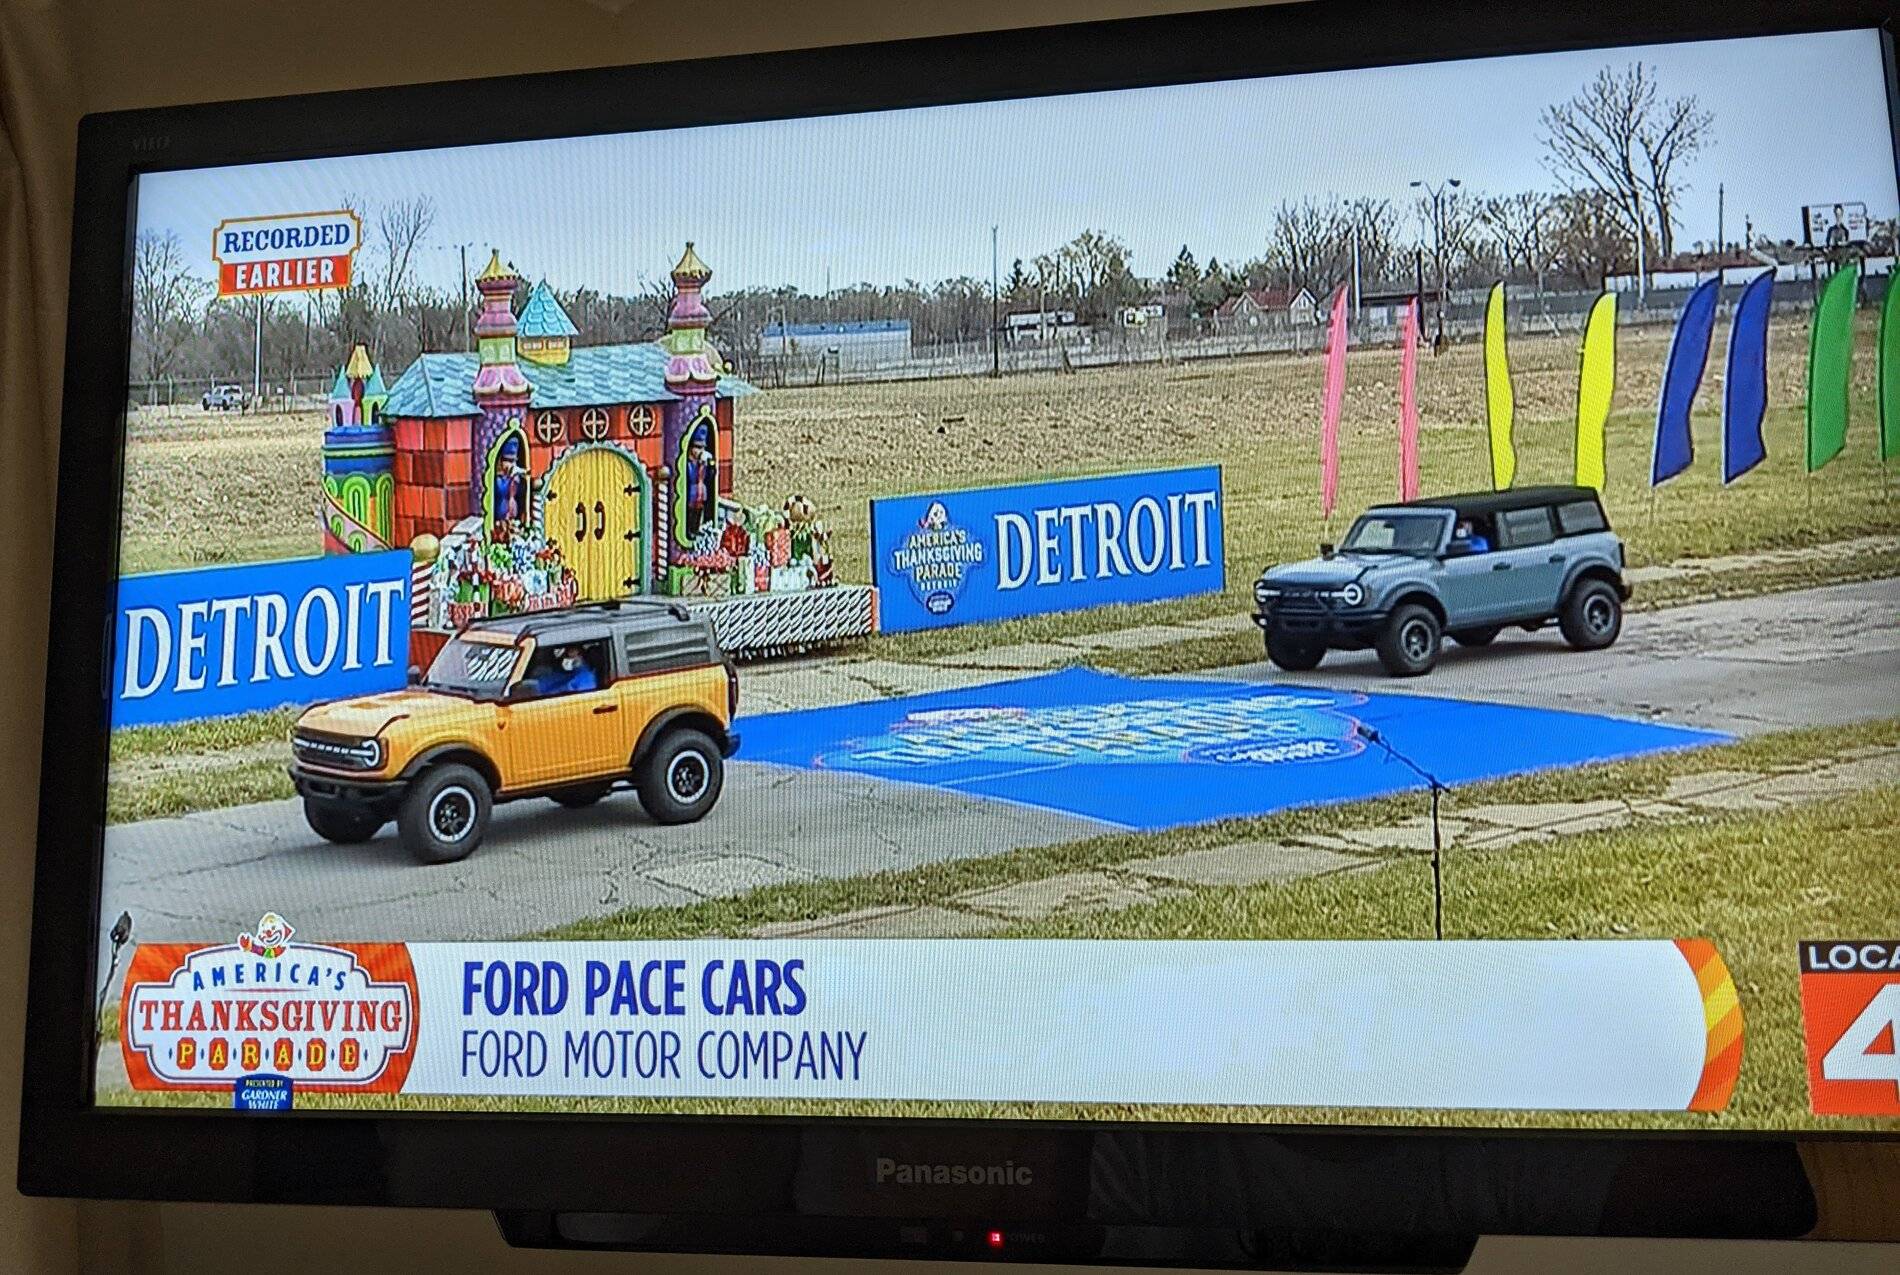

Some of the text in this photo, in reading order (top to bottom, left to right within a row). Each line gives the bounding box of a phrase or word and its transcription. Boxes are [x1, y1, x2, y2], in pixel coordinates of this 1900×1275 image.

[223, 222, 351, 253] RECORDED
[235, 259, 335, 290] EARLIER
[910, 530, 966, 548] AMERICA'S
[994, 490, 1217, 591] DETROIT
[894, 543, 981, 570] THANKSGIVING
[916, 563, 962, 581] PARADE
[120, 578, 405, 699] DETROIT
[192, 962, 347, 992] AMERICA'S
[462, 959, 808, 1016] FORD PACE CARS
[139, 1000, 402, 1032] THANKSGIVING
[178, 1041, 358, 1067] PARADE
[462, 1030, 868, 1080] FORD MOTOR COMPANY
[241, 1089, 288, 1101] GARDNER
[876, 1158, 1033, 1186] Panasonic
